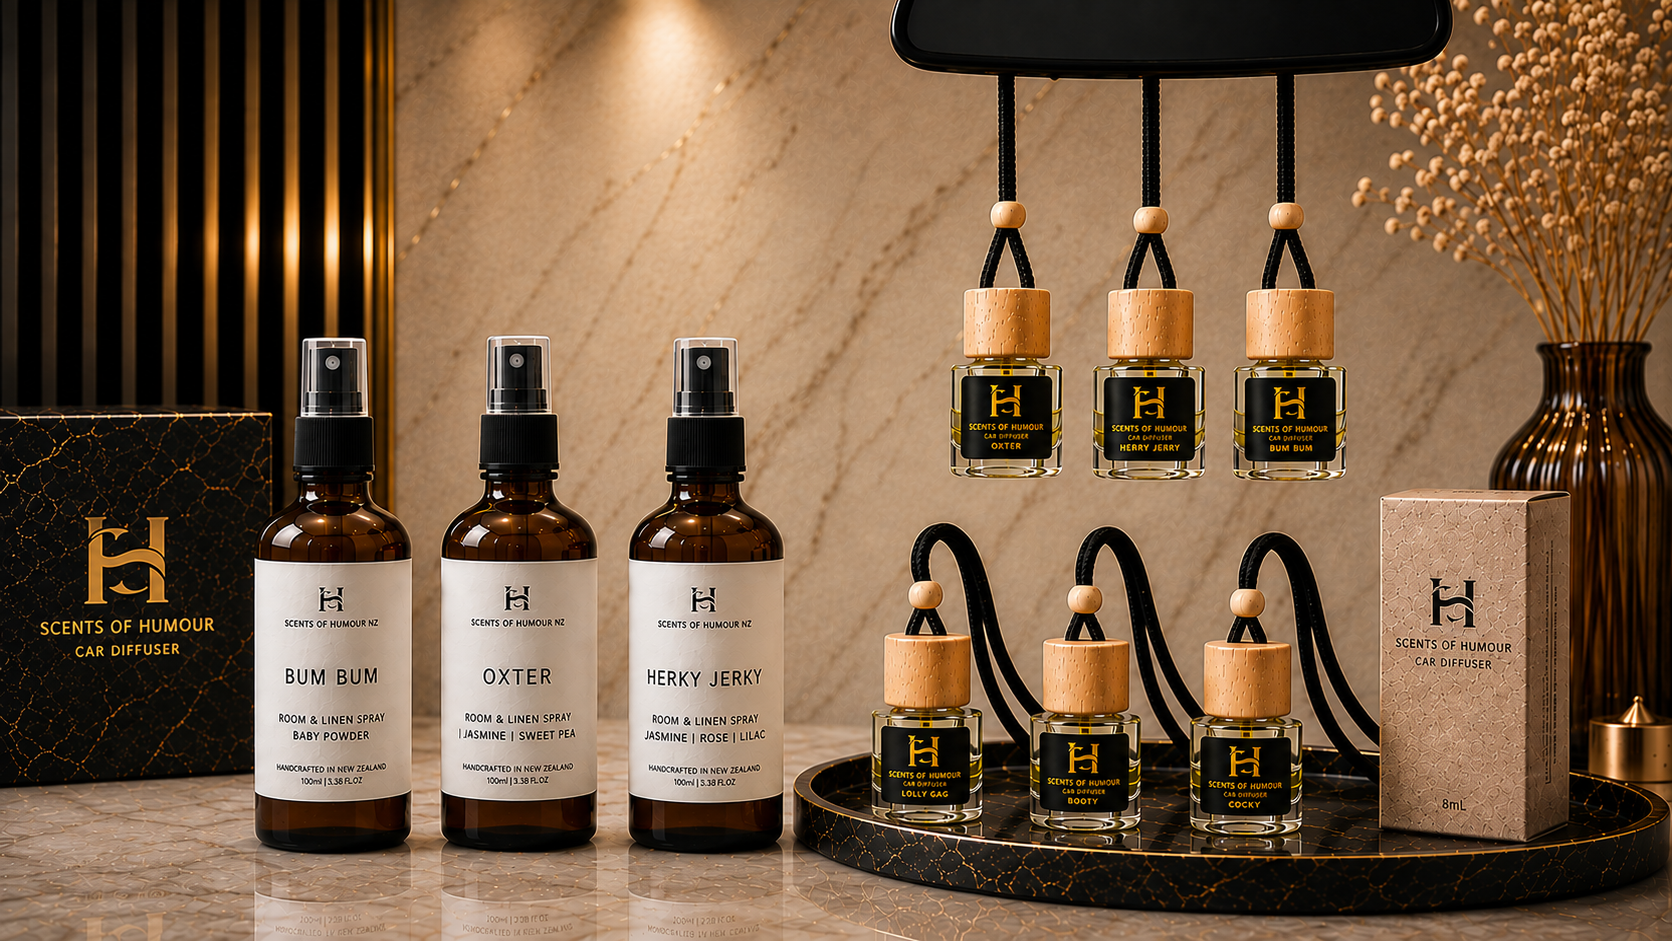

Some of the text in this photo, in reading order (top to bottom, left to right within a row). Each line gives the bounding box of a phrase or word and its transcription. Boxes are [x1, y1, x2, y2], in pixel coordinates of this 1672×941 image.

[40, 617, 214, 636] SCENTS OF HUMOUR
[285, 619, 314, 628] SCENTS
[330, 620, 366, 628] HUMOUR
[471, 618, 500, 627] SCENTS
[516, 619, 553, 627] HUMOUR
[658, 620, 687, 629] SCENTS
[703, 620, 740, 629] HUMOUR
[75, 643, 180, 658] CAR DIFFUSER
[1396, 638, 1512, 653] SCENTS OF HUMOUR
[1415, 656, 1492, 670] CAR DIFFUSER
[286, 668, 377, 685] BUM BUM
[483, 668, 551, 685] OXTER
[648, 668, 762, 687] HERKY JERKY
[279, 713, 385, 725] ROOM & LINEN SPRAY
[465, 712, 571, 724] ROOM & LINEN SPRAY
[652, 714, 758, 726] ROOM & LINEN SPRAY
[293, 730, 369, 741] BABY POWDER
[463, 730, 506, 740] JASMINE
[519, 730, 555, 740] SWEET
[558, 729, 576, 739] PEA
[645, 731, 687, 742] JASMINE
[700, 733, 728, 743] ROSE
[740, 730, 765, 741] LILAC
[277, 764, 325, 773] HANDCRAFTED
[356, 763, 386, 772] ZEALAND
[463, 763, 512, 773] HANDCRAFTED
[543, 763, 574, 772] ZEALAND
[648, 764, 698, 774] HANDCRAFTED
[730, 764, 760, 774] ZEALAND
[888, 770, 914, 779] SCENTS
[1047, 777, 1074, 786] SCENTS
[1089, 778, 1120, 786] HUMOUR
[1208, 780, 1235, 790] SCENTS
[1228, 800, 1260, 808] COCKY
[1442, 798, 1466, 811] 8mL
